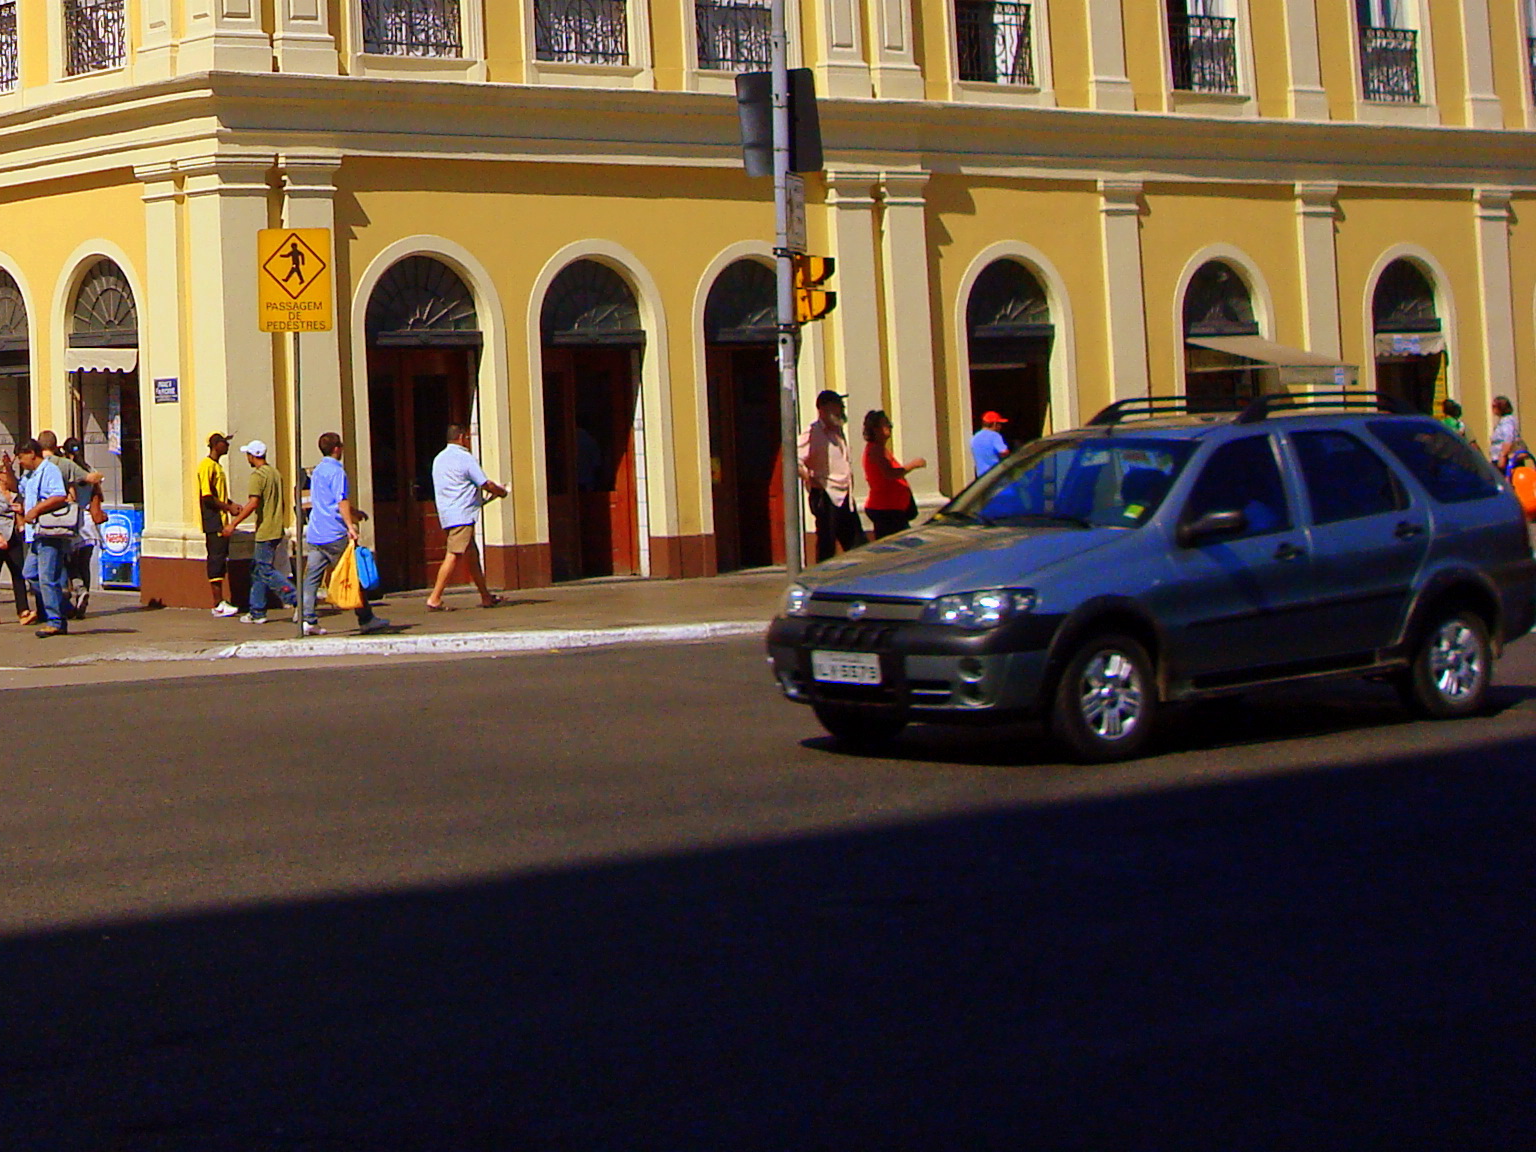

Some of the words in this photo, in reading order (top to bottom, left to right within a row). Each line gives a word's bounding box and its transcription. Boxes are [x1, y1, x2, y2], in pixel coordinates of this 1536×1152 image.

[266, 302, 323, 311] PASSAGEM
[288, 312, 302, 321] DE
[266, 321, 326, 330] PEDESTRES
